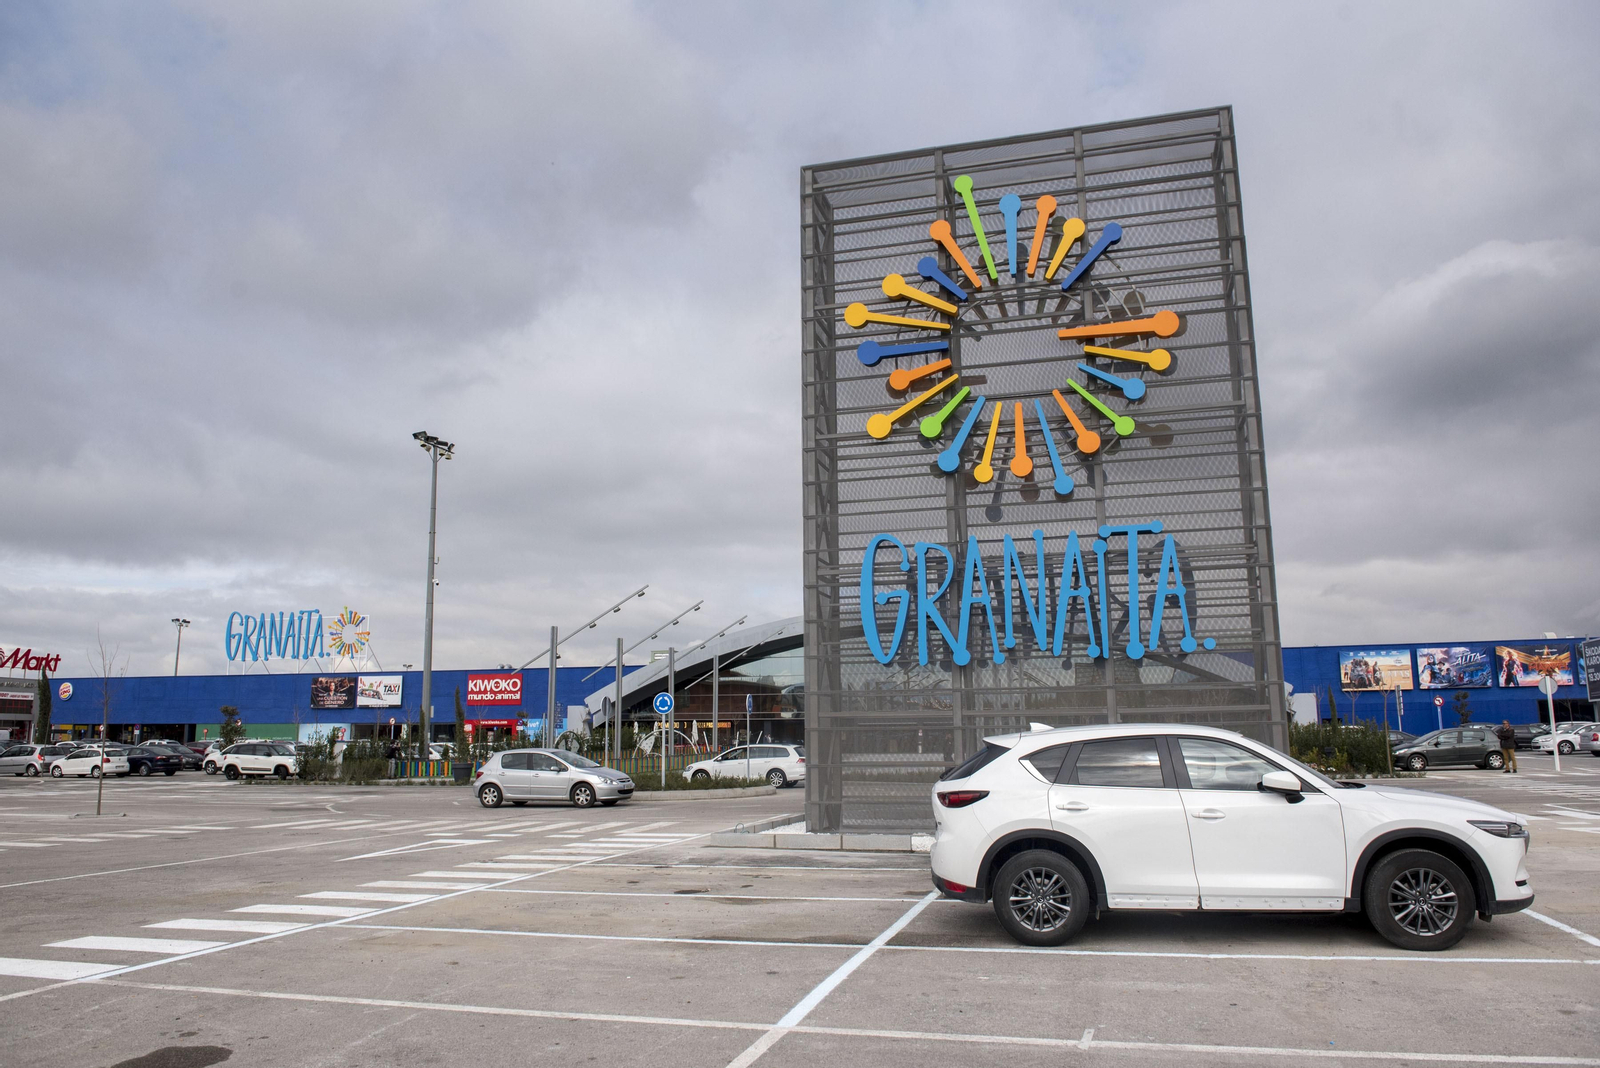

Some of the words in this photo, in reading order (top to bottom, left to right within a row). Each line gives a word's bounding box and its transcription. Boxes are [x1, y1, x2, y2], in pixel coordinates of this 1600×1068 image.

[0, 647, 61, 672] Markt
[1454, 650, 1484, 666] ALITA
[383, 684, 401, 692] TAXI
[468, 678, 521, 692] KIWOKO
[468, 692, 495, 700] mundo
[495, 691, 521, 700] animal
